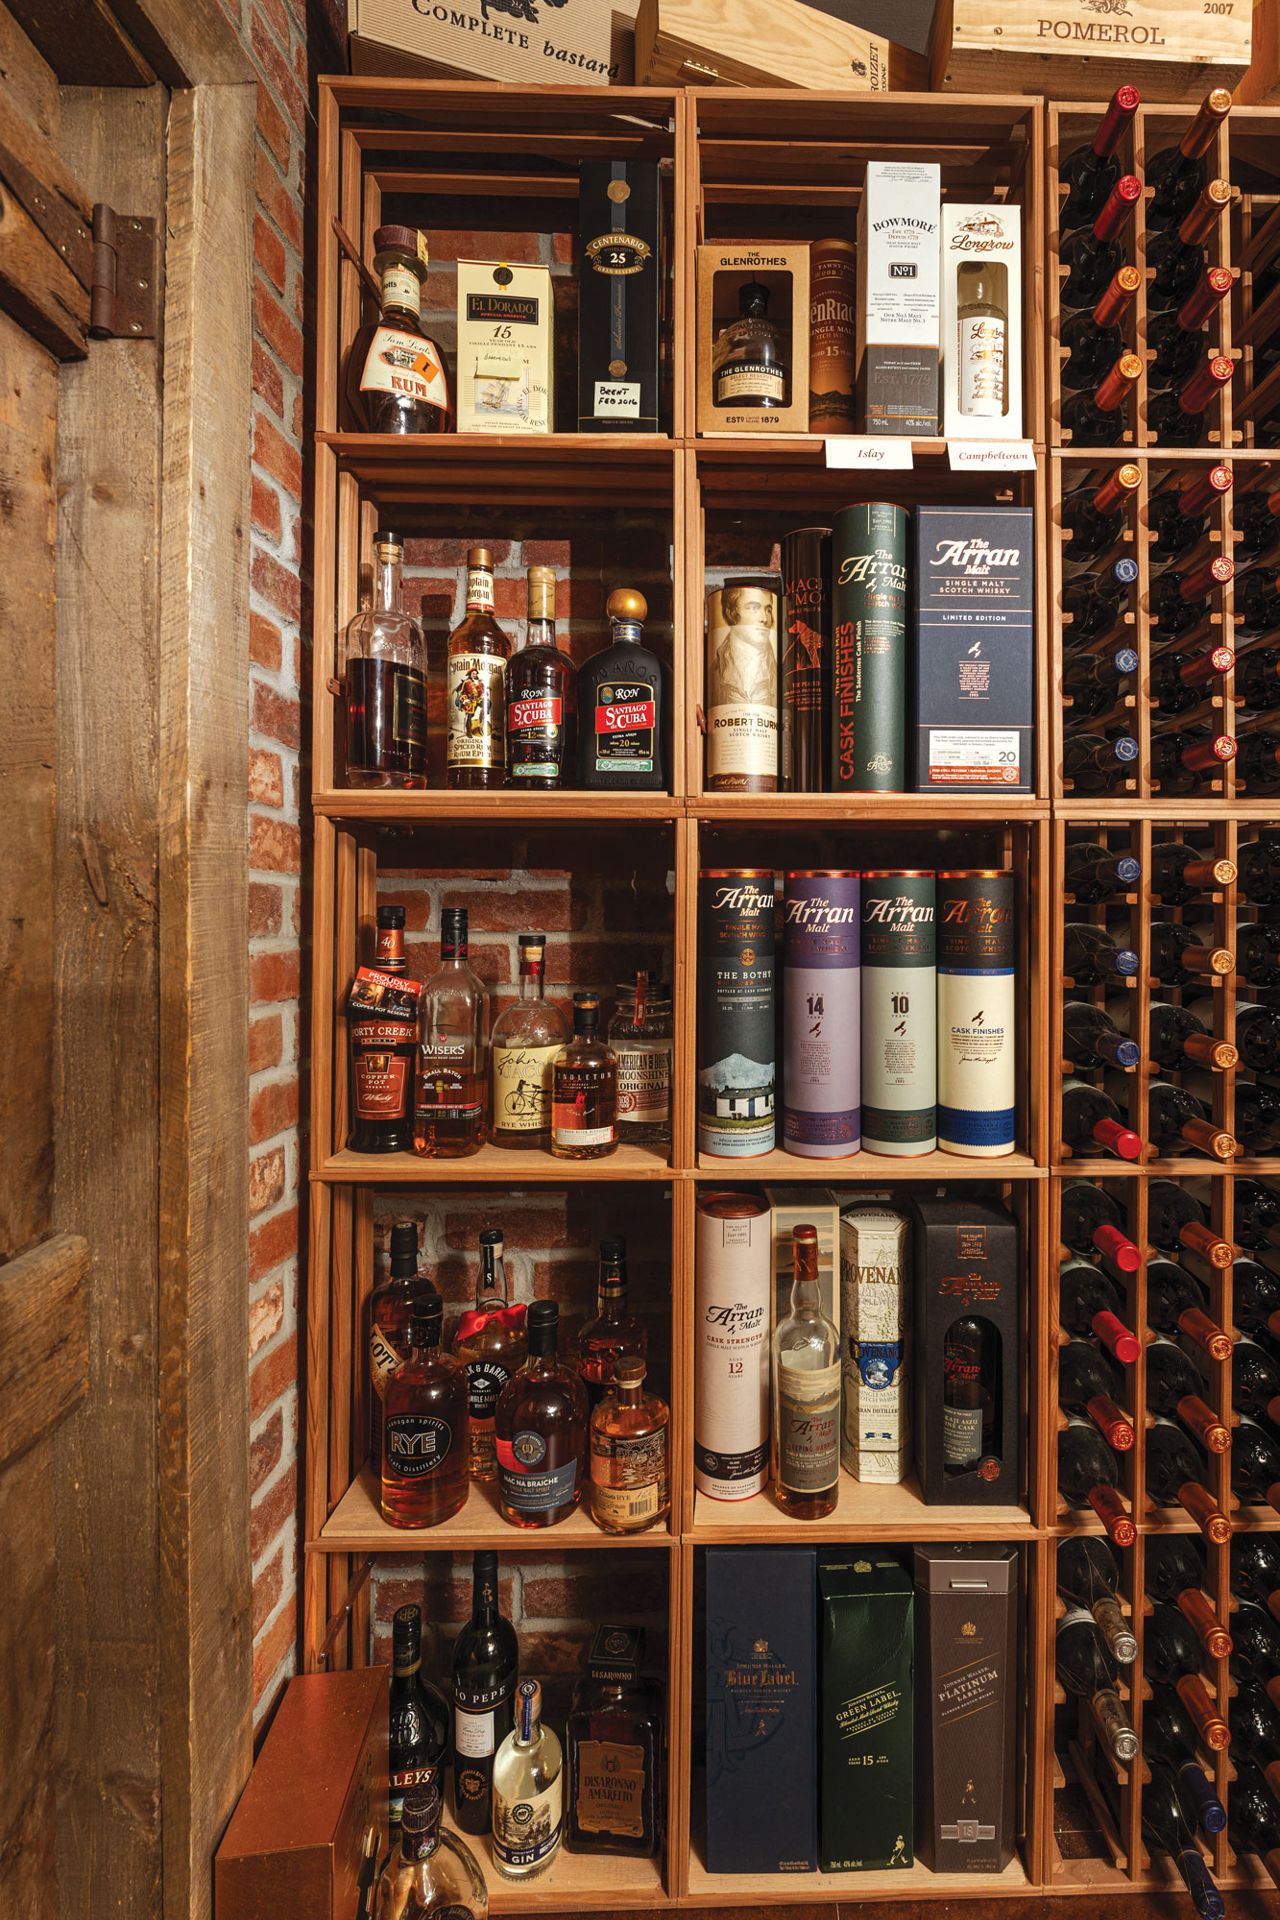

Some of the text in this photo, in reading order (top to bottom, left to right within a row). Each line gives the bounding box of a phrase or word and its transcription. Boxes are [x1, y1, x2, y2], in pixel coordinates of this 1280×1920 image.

[1203, 3, 1235, 17] 2007
[1037, 19, 1166, 46] POMEROL
[412, 0, 620, 79] COMPLETE bastard
[872, 217, 937, 234] BOWMORE
[592, 235, 645, 250] CENTENARIO
[949, 235, 1014, 253] Longrow
[610, 252, 626, 264] 25
[720, 257, 787, 267] GLENROTHES
[492, 324, 513, 340] 15
[825, 345, 840, 357] 15
[720, 364, 783, 378] THE GLENROTHES
[390, 374, 428, 398] RUM
[599, 386, 630, 396] BRENT
[761, 416, 780, 424] 1879
[858, 448, 1029, 462] Islay Campbeltown
[971, 538, 989, 550] The
[874, 549, 893, 561] The
[929, 540, 1020, 568] Arran
[964, 563, 991, 575] Malt
[945, 579, 1005, 588] SINGLE MALT
[939, 586, 1011, 595] SCOTCH WHISKY
[942, 614, 1007, 622] LIMITED EDITION
[520, 688, 545, 700] RON
[614, 687, 640, 701] RON
[838, 620, 855, 781] CASK FINISHES
[513, 700, 553, 722] SANTIAGO
[523, 708, 553, 725] CUBA
[605, 703, 647, 726] SANTIAGO
[616, 711, 647, 729] CUBA
[714, 717, 778, 731] ROBERT BURN
[527, 731, 537, 739] 12
[453, 743, 475, 751] SPICED
[619, 738, 630, 748] 20
[998, 751, 1017, 763] 20
[743, 885, 760, 895] The
[711, 887, 774, 909] Arran
[810, 897, 830, 907] The
[895, 896, 914, 907] The
[739, 908, 761, 917] Malt
[786, 899, 854, 924] Arran
[864, 899, 934, 923] Arran
[943, 899, 1012, 924] Arran
[805, 923, 831, 933] Malt
[889, 922, 916, 932] Malt
[381, 935, 396, 949] 40
[368, 971, 411, 988] PROUDLY
[717, 970, 772, 980] THE BOTHY
[372, 978, 417, 994] FORTY CREEK
[352, 1001, 410, 1018] COPPER POT RESERVE
[806, 996, 825, 1016] 14
[890, 995, 910, 1014] 10
[377, 1025, 413, 1037] CREEK
[951, 1026, 1005, 1035] CASK FINISHES
[496, 1050, 538, 1076] John
[422, 1067, 462, 1080] SMALL BATCH
[619, 1081, 667, 1091] ORIGINAL
[501, 1120, 517, 1128] RYE
[733, 1302, 748, 1311] The
[705, 1305, 764, 1327] Arran
[738, 1319, 762, 1331] Malt
[706, 1334, 724, 1344] CASK
[728, 1361, 744, 1374] 12
[391, 1430, 436, 1455] RYE
[515, 1478, 526, 1487] NA
[527, 1476, 559, 1488] BRAICHE
[591, 1669, 633, 1682] DISARONNO
[943, 1666, 990, 1690] JOHNNIE WALKER
[937, 1669, 998, 1702] PLATINUM
[472, 1685, 506, 1704] PEPE
[956, 1687, 985, 1702] LABEL
[835, 1690, 901, 1721] GREEN LABEL
[862, 1755, 874, 1766] 15
[584, 1775, 637, 1791] DISARONNO
[587, 1788, 633, 1801] AMARETTO
[962, 1825, 974, 1837] 18
[511, 1853, 535, 1865] GIN
